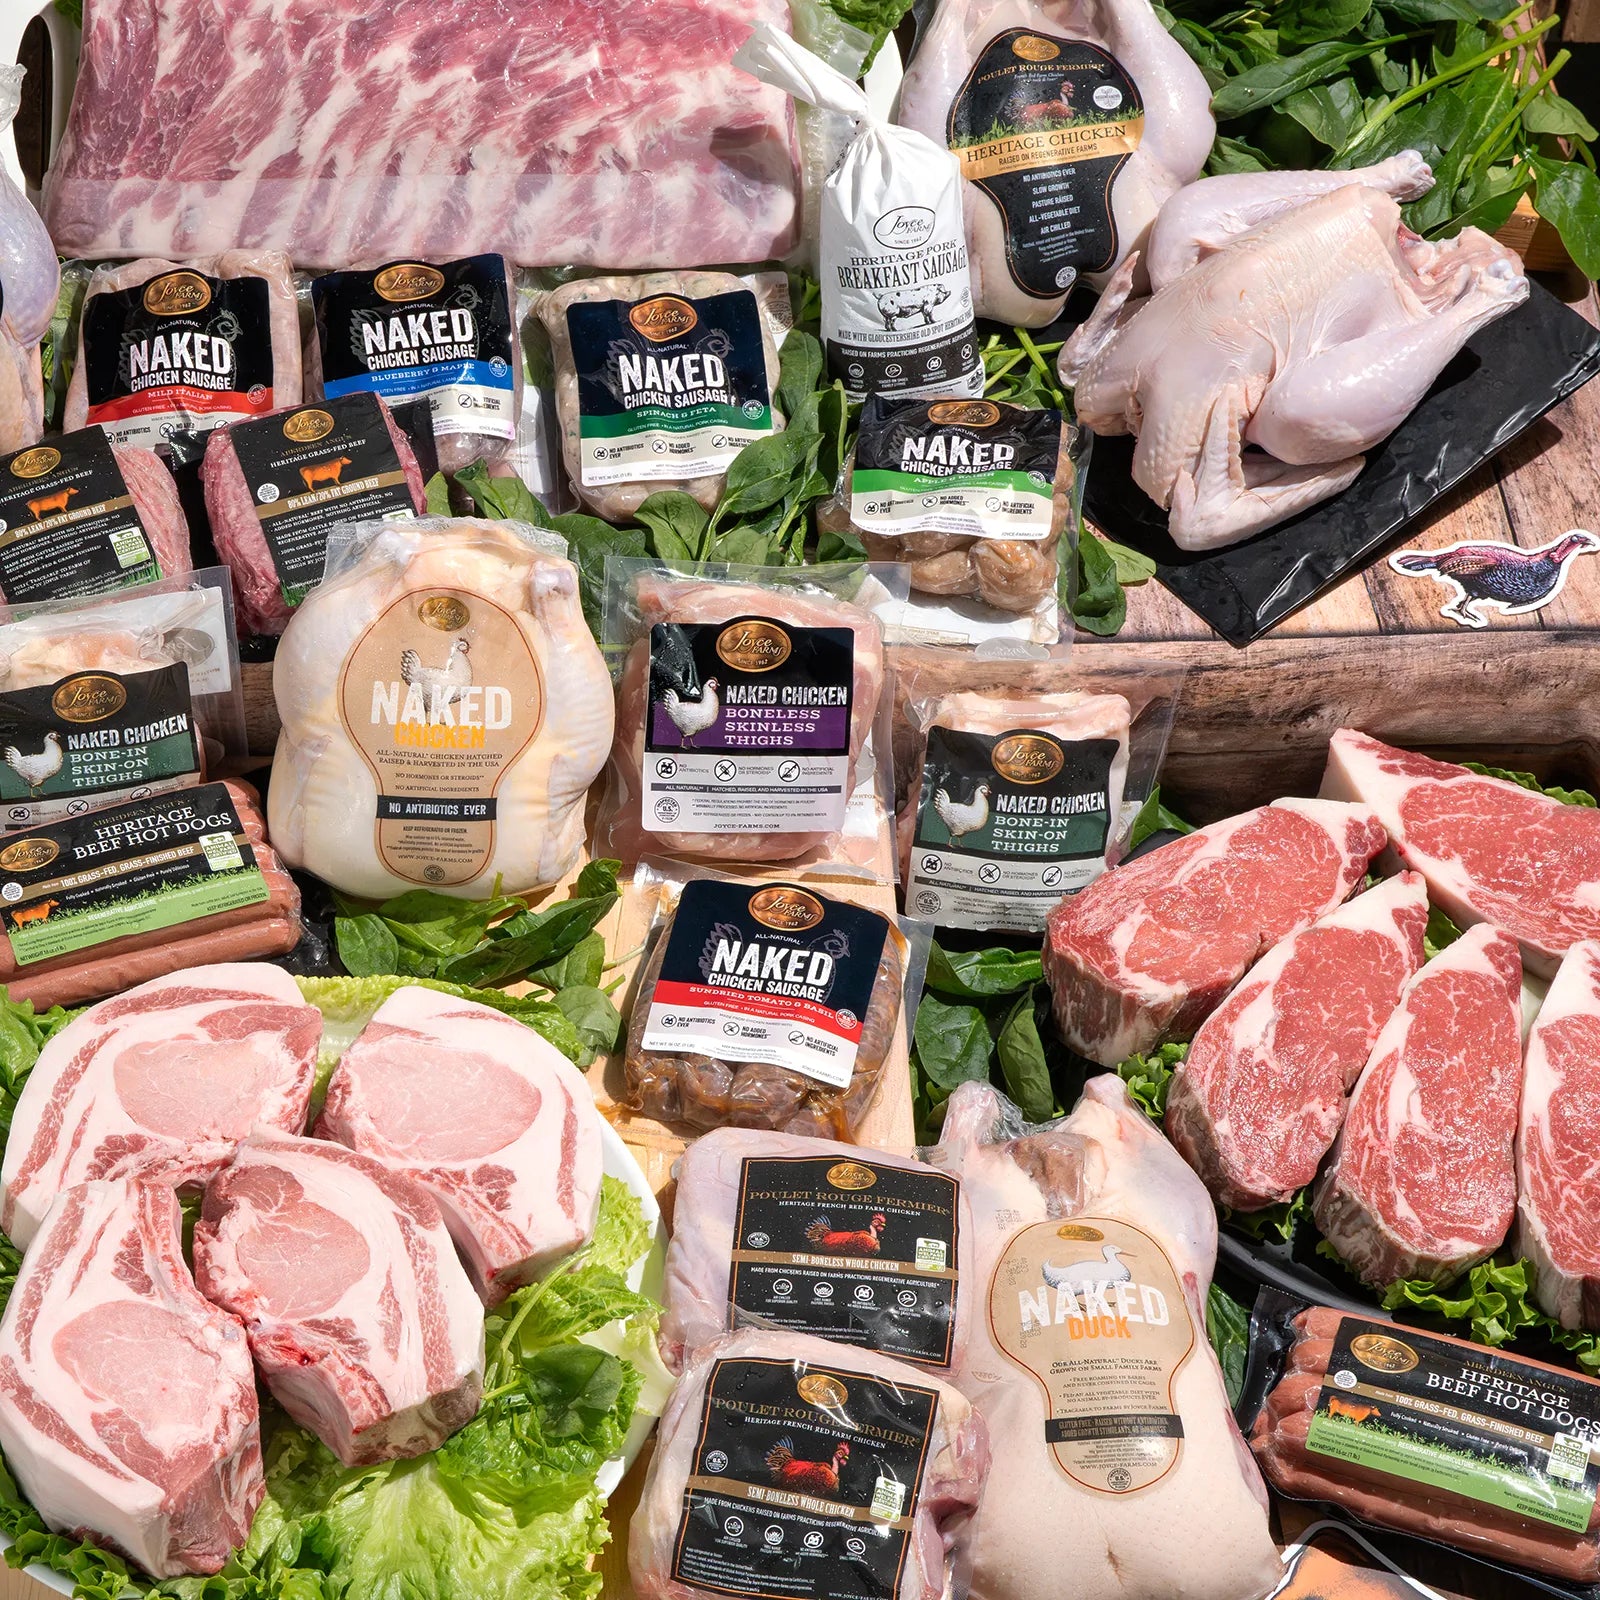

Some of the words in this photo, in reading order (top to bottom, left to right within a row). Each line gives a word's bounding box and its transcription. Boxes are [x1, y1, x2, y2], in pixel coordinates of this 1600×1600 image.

[967, 135, 1045, 162] HERITAGE
[1049, 125, 1126, 146] CHICKEN
[999, 154, 1020, 165] RAISED
[1021, 153, 1030, 161] ON
[1031, 146, 1075, 160] REGENERATIVE
[1077, 143, 1098, 154] FARMS
[1032, 186, 1047, 194] SLOW
[1048, 182, 1070, 192] GROWTH
[1032, 198, 1054, 208] PASTURE
[1055, 194, 1073, 204] RAISED
[878, 215, 924, 236] Joyce
[1041, 226, 1049, 235] AIR
[1050, 221, 1071, 232] CHILLED
[850, 249, 924, 266] HERITAGE
[926, 239, 957, 255] PORK
[390, 274, 425, 289] Joyce
[837, 262, 920, 289] BREAKFAST
[158, 282, 194, 301] Joyce
[644, 309, 679, 325] Joyce
[362, 308, 473, 355] NAKED
[838, 329, 851, 338] MADE
[852, 331, 867, 342] WITH
[868, 331, 920, 343] GLOUCESTERSHIRE
[920, 329, 931, 338] OLD
[931, 324, 944, 335] SPOT
[130, 332, 231, 377] NAKED
[367, 350, 419, 371] CHICKEN
[422, 344, 476, 364] SAUSAGE
[131, 371, 180, 393] CHICKEN
[183, 369, 232, 391] SAUSAGE
[619, 354, 725, 394] NAKED
[148, 389, 174, 399] MILD
[624, 391, 671, 409] CHICKEN
[675, 390, 728, 409] SAUSAGE
[270, 453, 308, 468] HERITAGE
[308, 444, 347, 458] GRASS-FED
[349, 439, 367, 447] BEEF
[902, 435, 1015, 467] NAKED
[901, 461, 953, 477] CHICKEN
[957, 461, 1012, 474] SAUSAGE
[729, 631, 772, 653] Joyce
[752, 645, 785, 656] FARMS
[66, 687, 107, 707] Joyce
[88, 695, 122, 706] FARMS
[726, 685, 777, 705] NAKED
[782, 686, 848, 706] CHICKEN
[370, 680, 512, 731] NAKED
[725, 709, 821, 720] BONELESS
[67, 729, 120, 750] NAKED
[124, 713, 188, 745] CHICKEN
[393, 722, 488, 750] CHICKEN
[725, 722, 816, 733] SKINLESS
[724, 735, 794, 746] THIGHS
[70, 746, 148, 763] BONE-IN
[376, 750, 426, 758] ALL-NATURAL
[1005, 745, 1046, 765] Joyce
[72, 758, 149, 775] SKIN-ON
[1024, 759, 1059, 769] FARMS
[72, 770, 143, 787] THIGHS
[389, 802, 400, 813] NO
[406, 804, 459, 815] ANTIBIOTICS
[464, 805, 486, 815] EVER
[996, 794, 1047, 814] NAKED
[1051, 792, 1105, 815] CHICKEN
[95, 806, 196, 840] HERITAGE
[994, 815, 1069, 828] BONE-IN
[72, 839, 122, 861] BEEF
[127, 828, 172, 848] HOT
[175, 812, 232, 835] DOGS
[993, 828, 1067, 840] SKIN-ON
[10, 846, 43, 863] Joyce
[992, 840, 1059, 853] THIGHS
[60, 877, 78, 888] 100%
[120, 851, 176, 872] GRASS-FINISHED
[176, 846, 195, 859] BEEF
[765, 896, 806, 917] Joyce
[784, 909, 816, 921] FARMS
[754, 933, 801, 945] ALL-NATURAL
[711, 938, 833, 987] NAKED
[707, 972, 763, 992] CHICKEN
[765, 980, 825, 1002] SAUSAGE
[689, 986, 745, 1000] SUNDRIED
[747, 994, 792, 1007] TOMATO
[803, 1004, 834, 1020] BASIL
[686, 1017, 716, 1025] ANTIBIOTICS
[750, 1026, 766, 1034] ADDED
[741, 1031, 767, 1039] HORMONES
[804, 1042, 836, 1057] INGREDIENTS
[815, 1038, 839, 1052] ARTIFICIAL
[750, 1191, 813, 1200] POULET
[815, 1192, 872, 1204] ROUGE
[817, 1201, 846, 1209] FRENCH
[865, 1205, 885, 1213] FARM
[887, 1208, 921, 1216] CHICKEN
[792, 1254, 844, 1267] SEMI-BONELESS
[845, 1259, 869, 1269] WHOLE
[870, 1260, 899, 1271] CHICKEN
[1018, 1279, 1171, 1332] NAKED
[1068, 1314, 1132, 1341] DUCK
[1366, 1341, 1402, 1357] Joyce
[1050, 1366, 1077, 1375] GROWN
[1460, 1368, 1570, 1410] HERITAGE
[1426, 1372, 1479, 1399] BEEF
[1484, 1389, 1537, 1415] HOT
[1538, 1407, 1600, 1435] DOGS
[714, 1398, 780, 1417] POULET
[845, 1422, 915, 1447] ERMIER
[1394, 1393, 1413, 1405] 100%
[1461, 1411, 1524, 1438] GRASS-FINISHED
[1525, 1428, 1545, 1445] BEEF
[744, 1416, 782, 1426] HERITAGE
[782, 1420, 813, 1431] FRENCH
[815, 1426, 830, 1435] RED
[832, 1429, 852, 1441] FARM
[853, 1435, 886, 1449] CHICKEN
[747, 1486, 800, 1507] SEMI-BONELESS
[800, 1495, 825, 1512] WHOLE
[825, 1501, 856, 1518] CHICKEN
